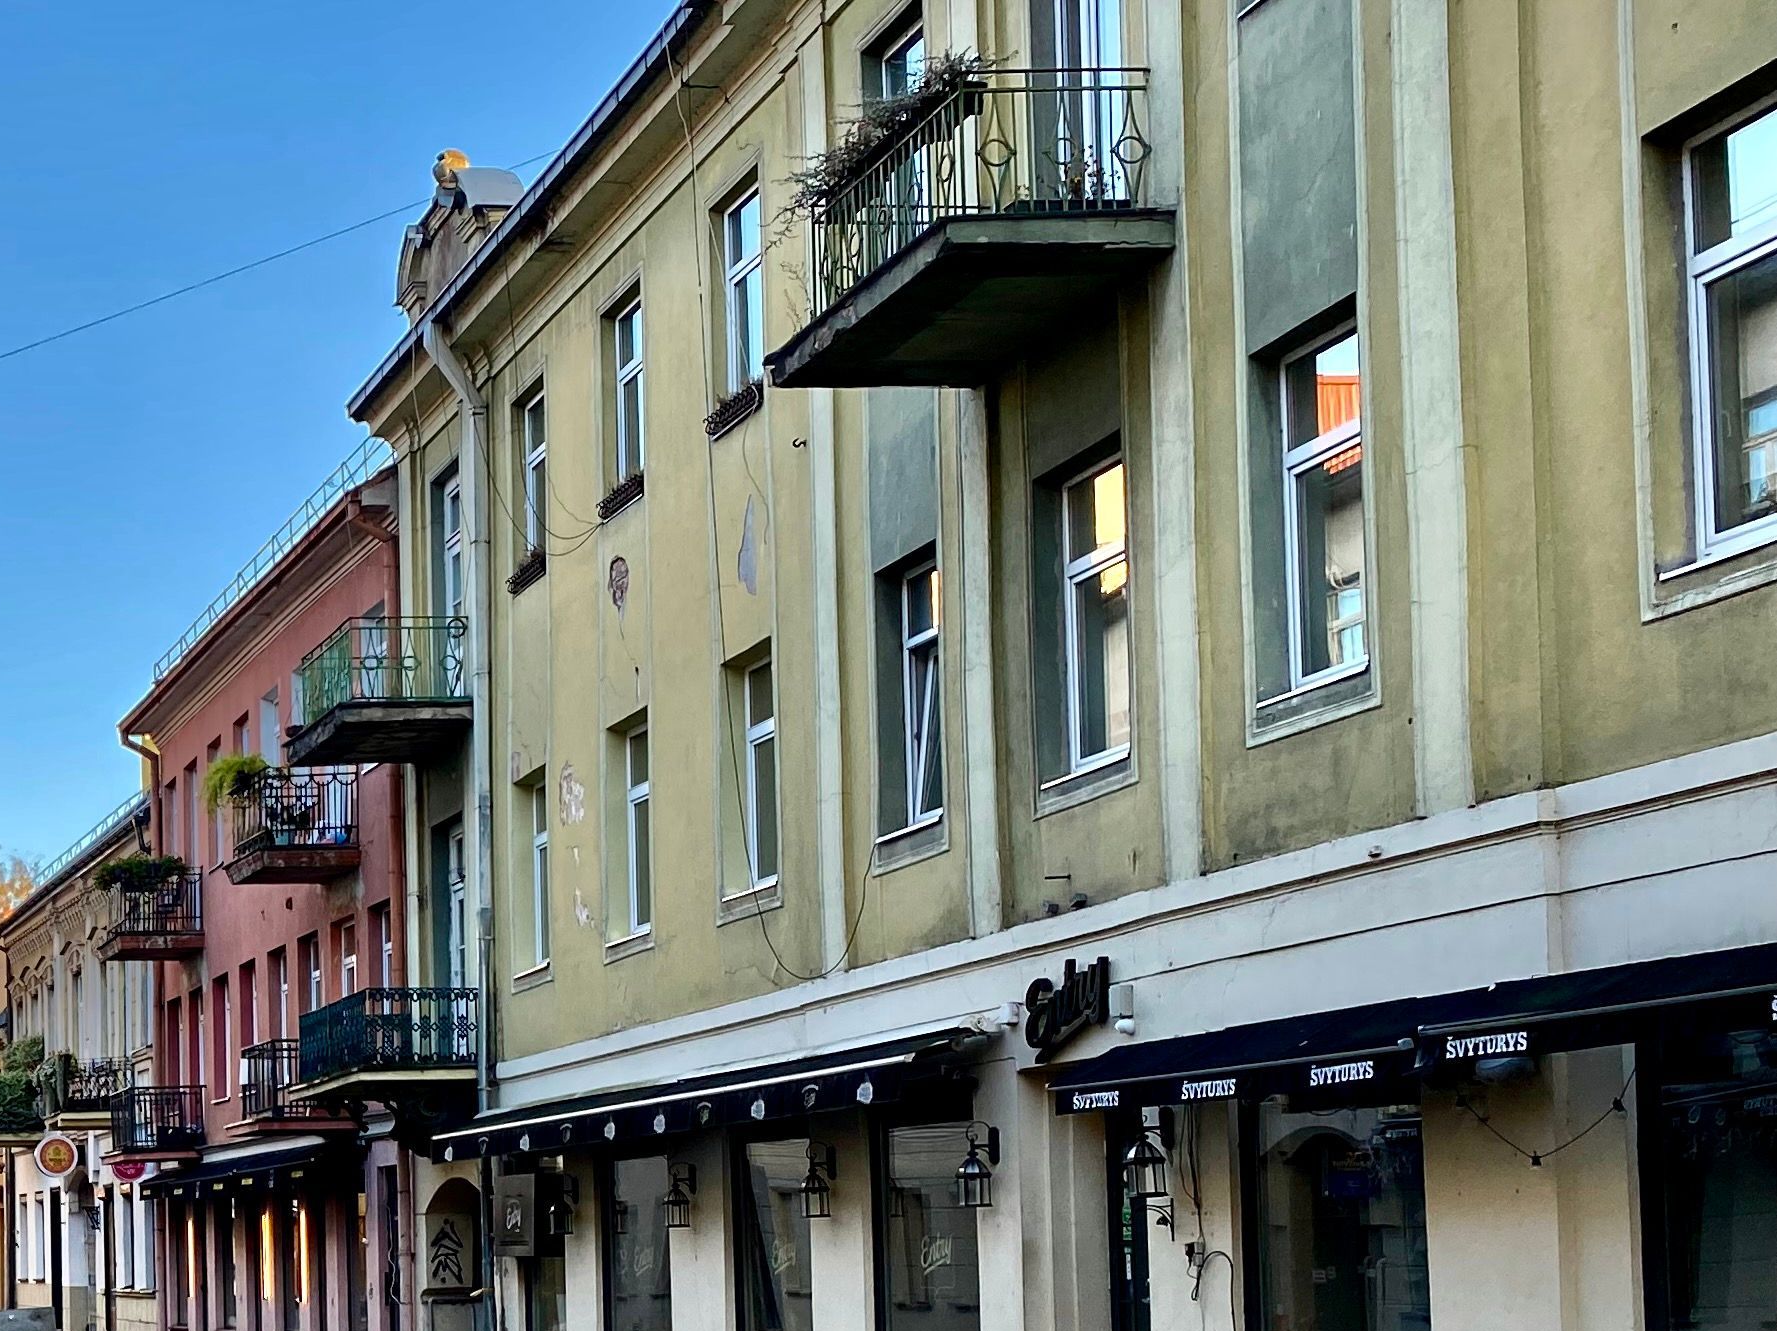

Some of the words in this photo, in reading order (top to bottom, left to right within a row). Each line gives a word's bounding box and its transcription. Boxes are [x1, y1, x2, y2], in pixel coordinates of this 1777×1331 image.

[1445, 1031, 1528, 1060] ŠVYTURYS
[1309, 1060, 1374, 1087] ŠVYTURYS
[1180, 1078, 1237, 1100] ŠVYTURYS
